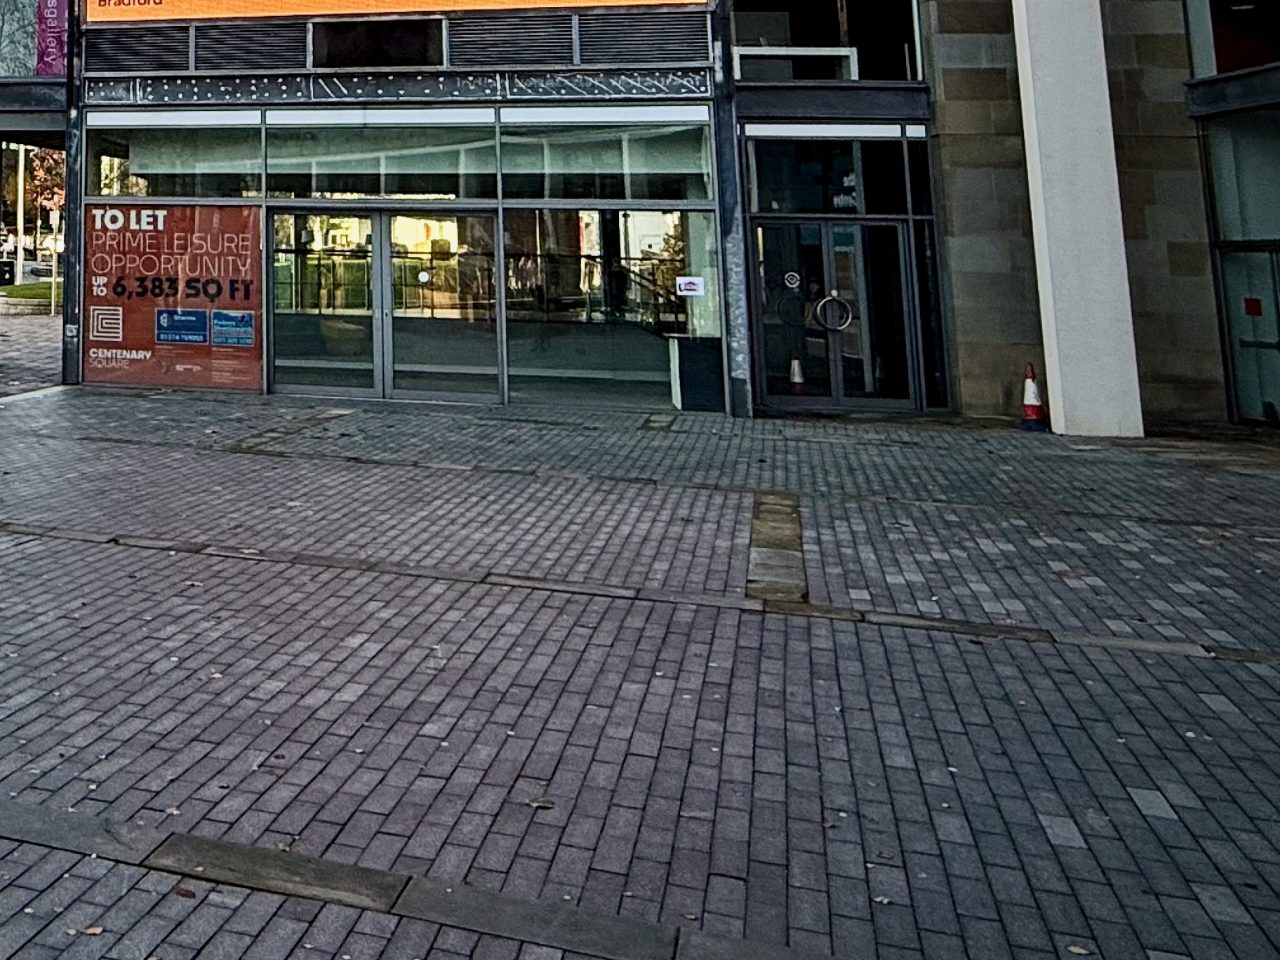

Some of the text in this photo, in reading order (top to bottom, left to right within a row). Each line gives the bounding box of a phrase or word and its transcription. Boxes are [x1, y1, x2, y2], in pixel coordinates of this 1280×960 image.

[92, 209, 168, 231] TO LET
[92, 231, 252, 255] PRIME LEISURE
[91, 253, 251, 277] OPPORTUNITY
[92, 276, 108, 286] UP
[92, 286, 108, 296] TO
[112, 275, 254, 303] 6,383 SQ FT
[89, 348, 152, 360] CENTENARY
